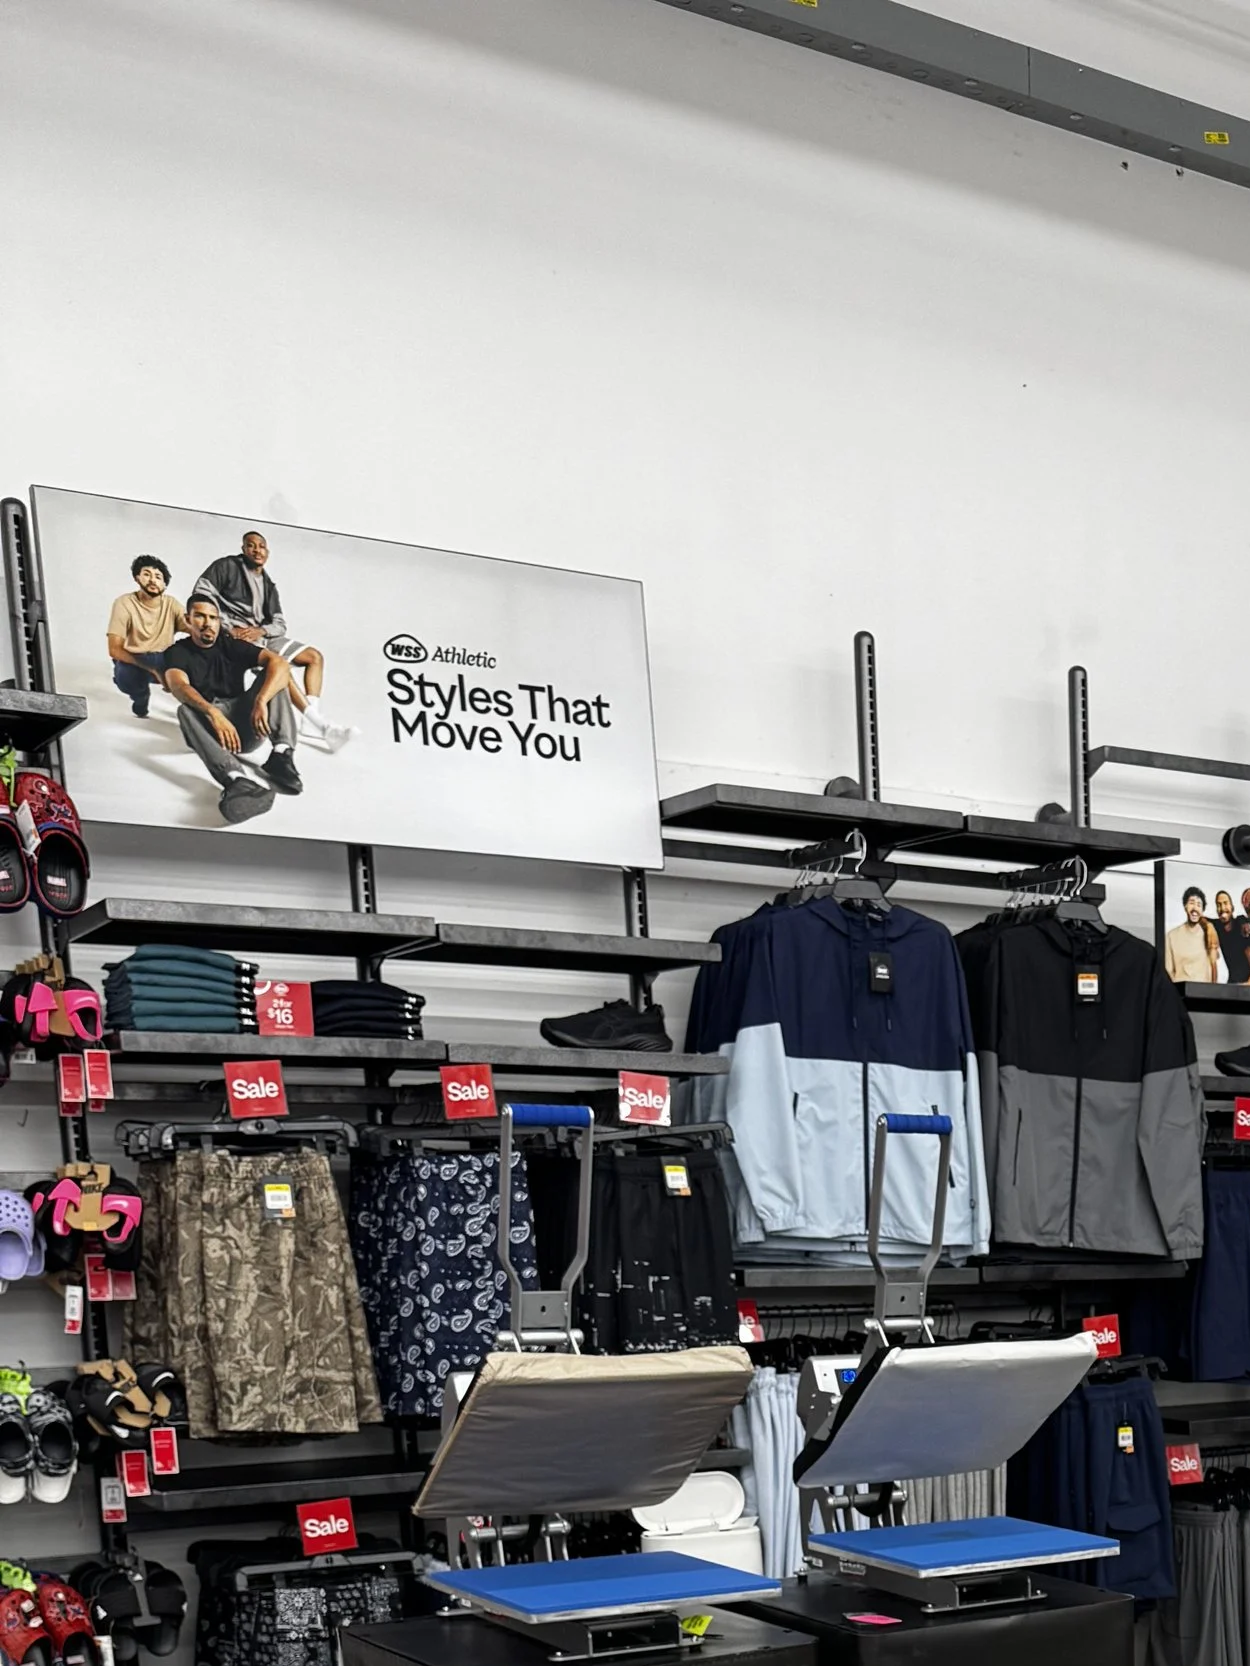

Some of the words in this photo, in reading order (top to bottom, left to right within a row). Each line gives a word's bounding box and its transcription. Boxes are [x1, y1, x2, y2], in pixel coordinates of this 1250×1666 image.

[390, 643, 422, 659] WSS
[431, 646, 497, 669] Athletic
[386, 668, 514, 721] Styles
[518, 683, 612, 728] That
[391, 707, 503, 754] Move
[507, 720, 582, 762] You
[267, 1007, 294, 1025] $16
[232, 1076, 279, 1100] Sale
[447, 1079, 490, 1102] Sale
[624, 1087, 664, 1109] Sale
[1091, 1327, 1117, 1345] Sale
[1170, 1455, 1198, 1472] Sale
[304, 1514, 349, 1538] Sale
